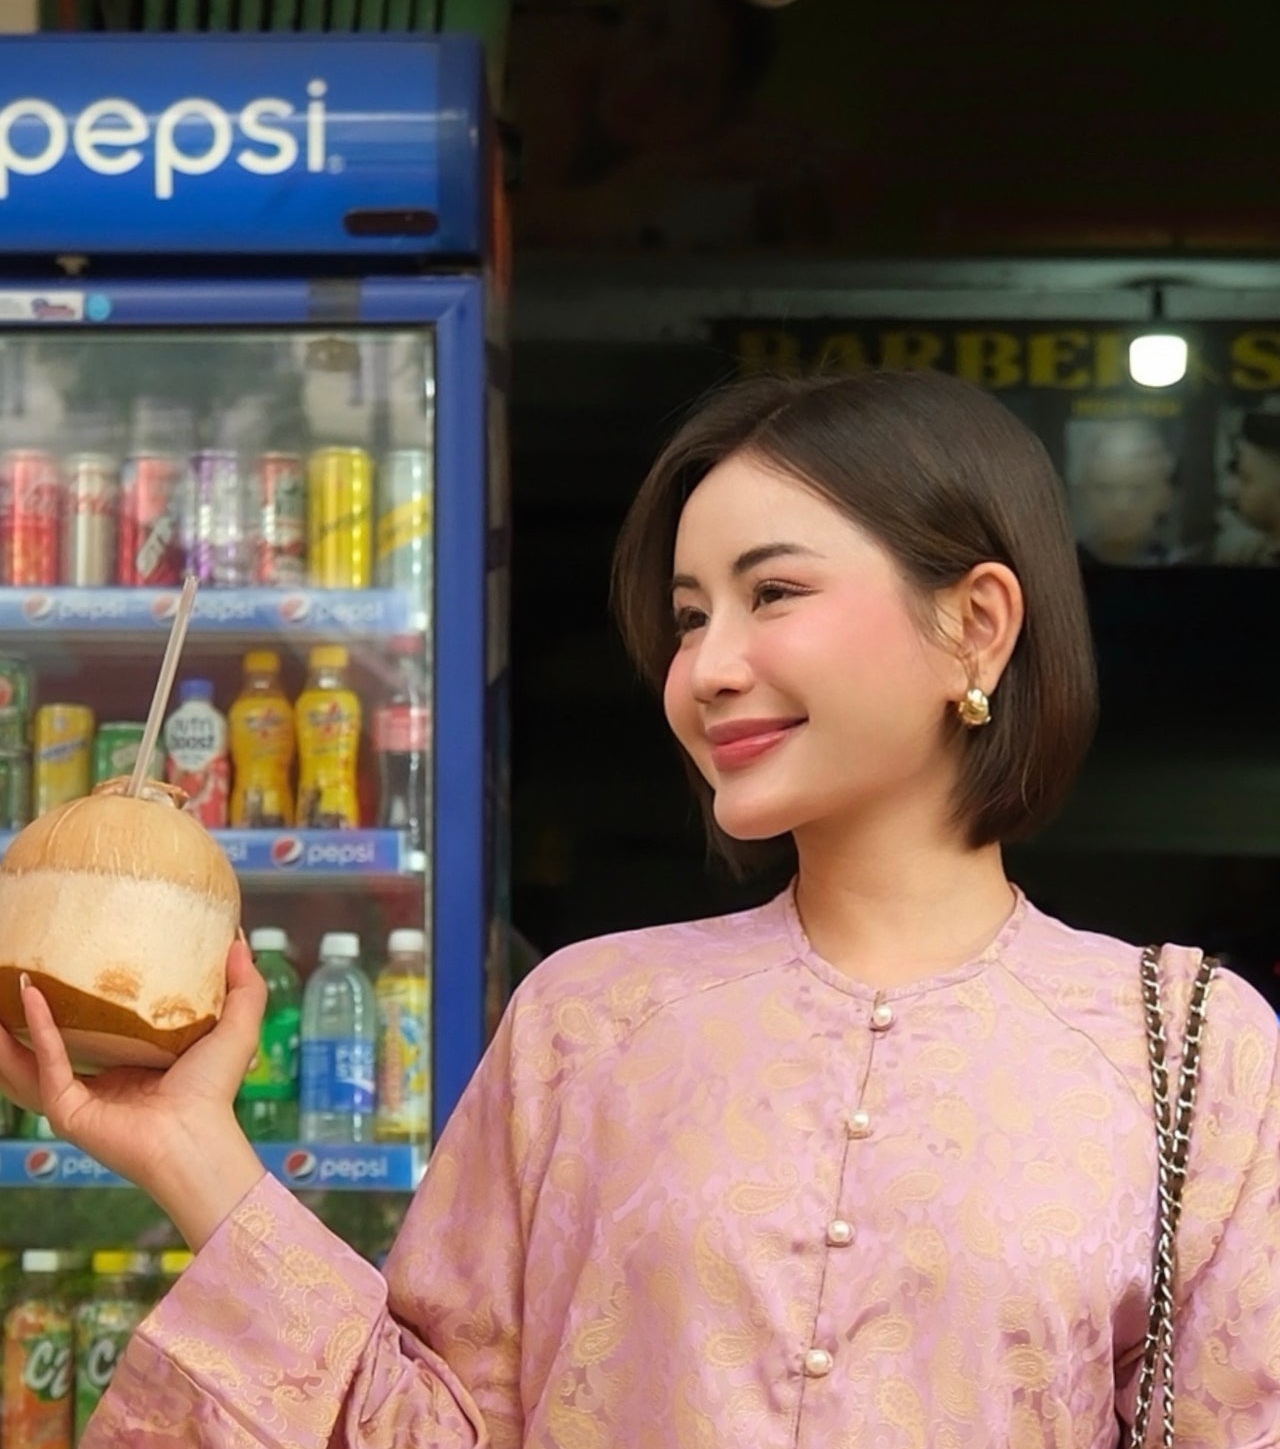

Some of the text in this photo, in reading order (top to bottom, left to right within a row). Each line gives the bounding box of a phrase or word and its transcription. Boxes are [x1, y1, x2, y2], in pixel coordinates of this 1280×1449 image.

[306, 841, 376, 866] pepsi
[62, 1154, 111, 1177] pep
[319, 1156, 388, 1180] pepsi
